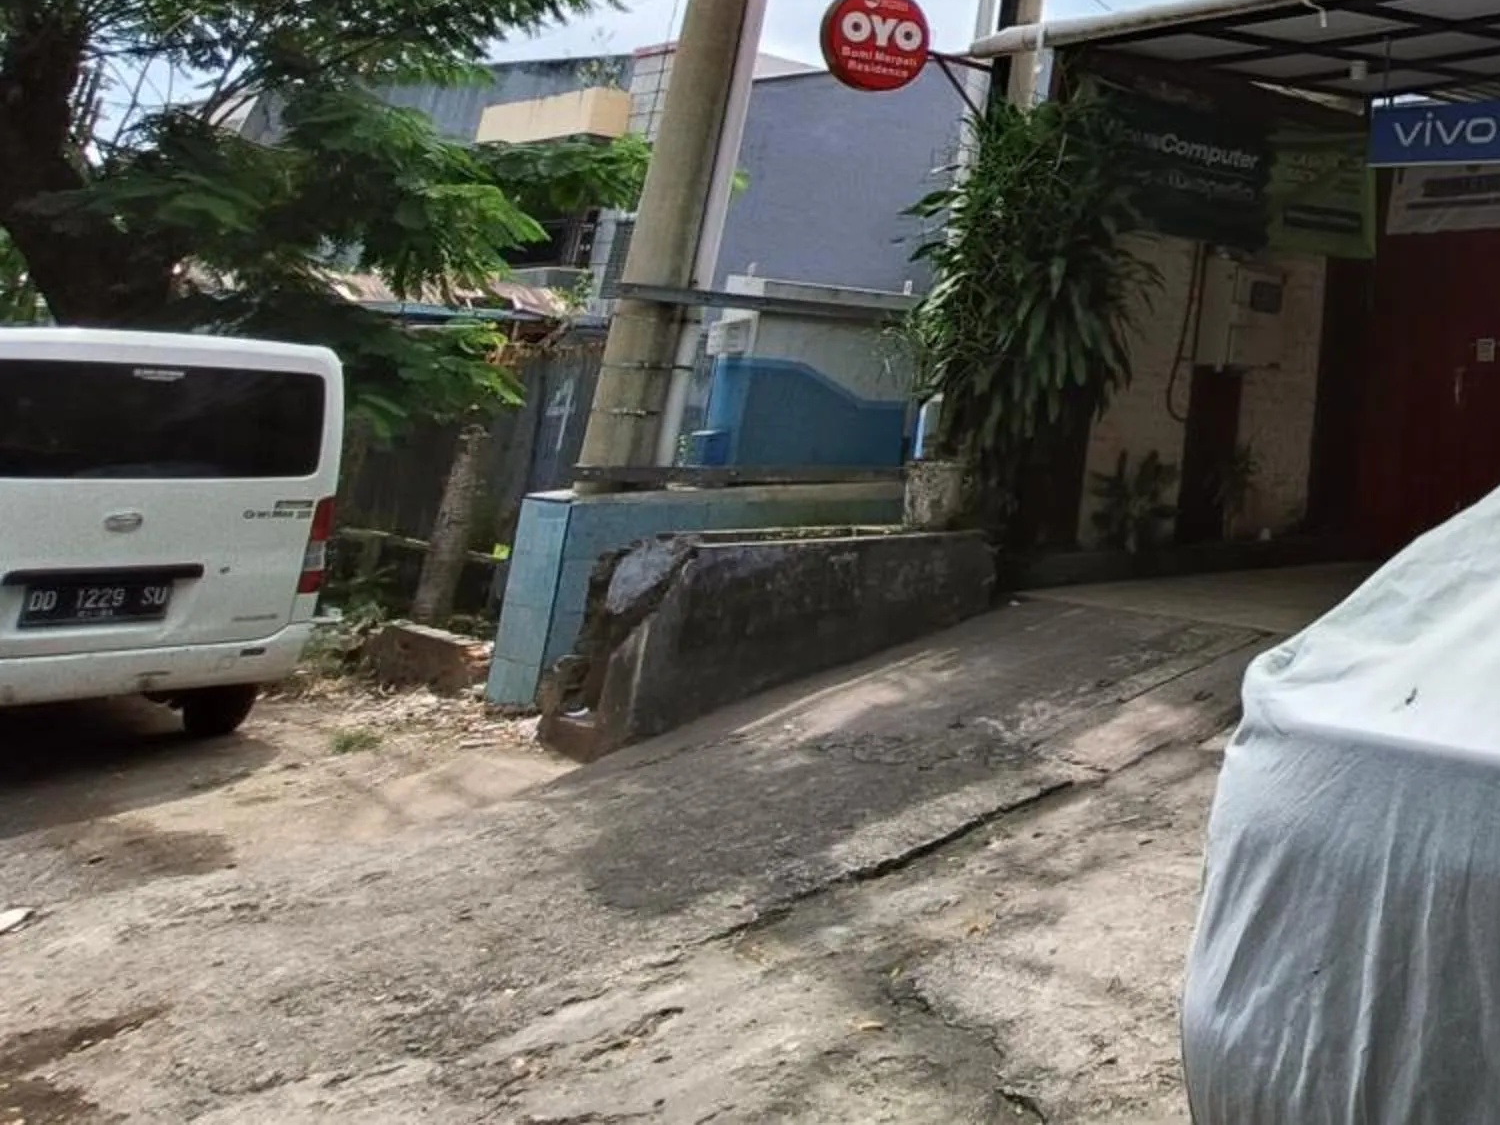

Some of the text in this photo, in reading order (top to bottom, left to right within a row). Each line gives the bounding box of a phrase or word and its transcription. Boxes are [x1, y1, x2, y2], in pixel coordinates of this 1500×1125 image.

[842, 11, 922, 51] OYO
[1393, 111, 1497, 147] vivo
[28, 586, 168, 612] DD 1229 SU
